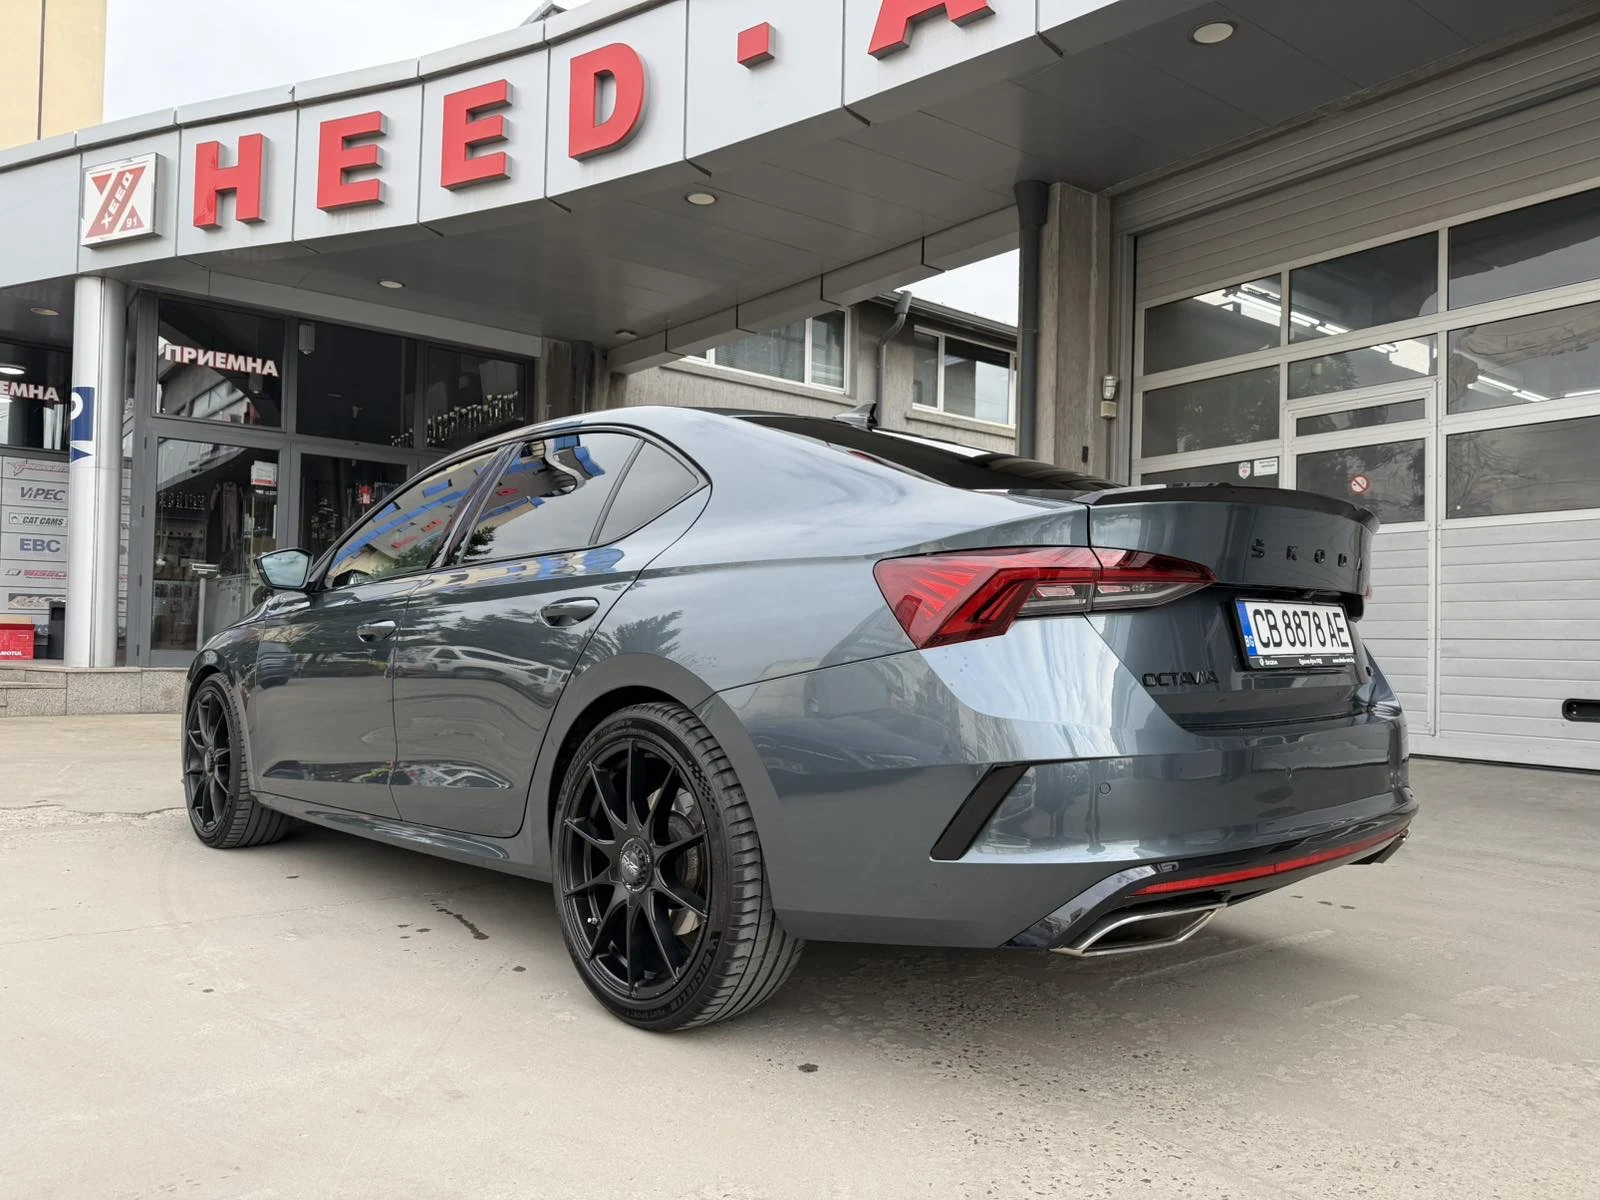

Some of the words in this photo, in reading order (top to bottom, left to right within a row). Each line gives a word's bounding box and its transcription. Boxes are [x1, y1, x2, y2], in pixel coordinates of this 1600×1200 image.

[193, 42, 648, 229] HEED
[164, 344, 279, 377] ПРИЕМНА
[23, 516, 39, 525] CAT
[40, 517, 64, 526] CAMS
[20, 538, 61, 553] EBC
[1253, 609, 1282, 648] CB
[1282, 610, 1326, 648] 8878
[1326, 611, 1349, 648] AE
[1244, 635, 1255, 648] BG
[1142, 671, 1219, 687] OCTAVIA
